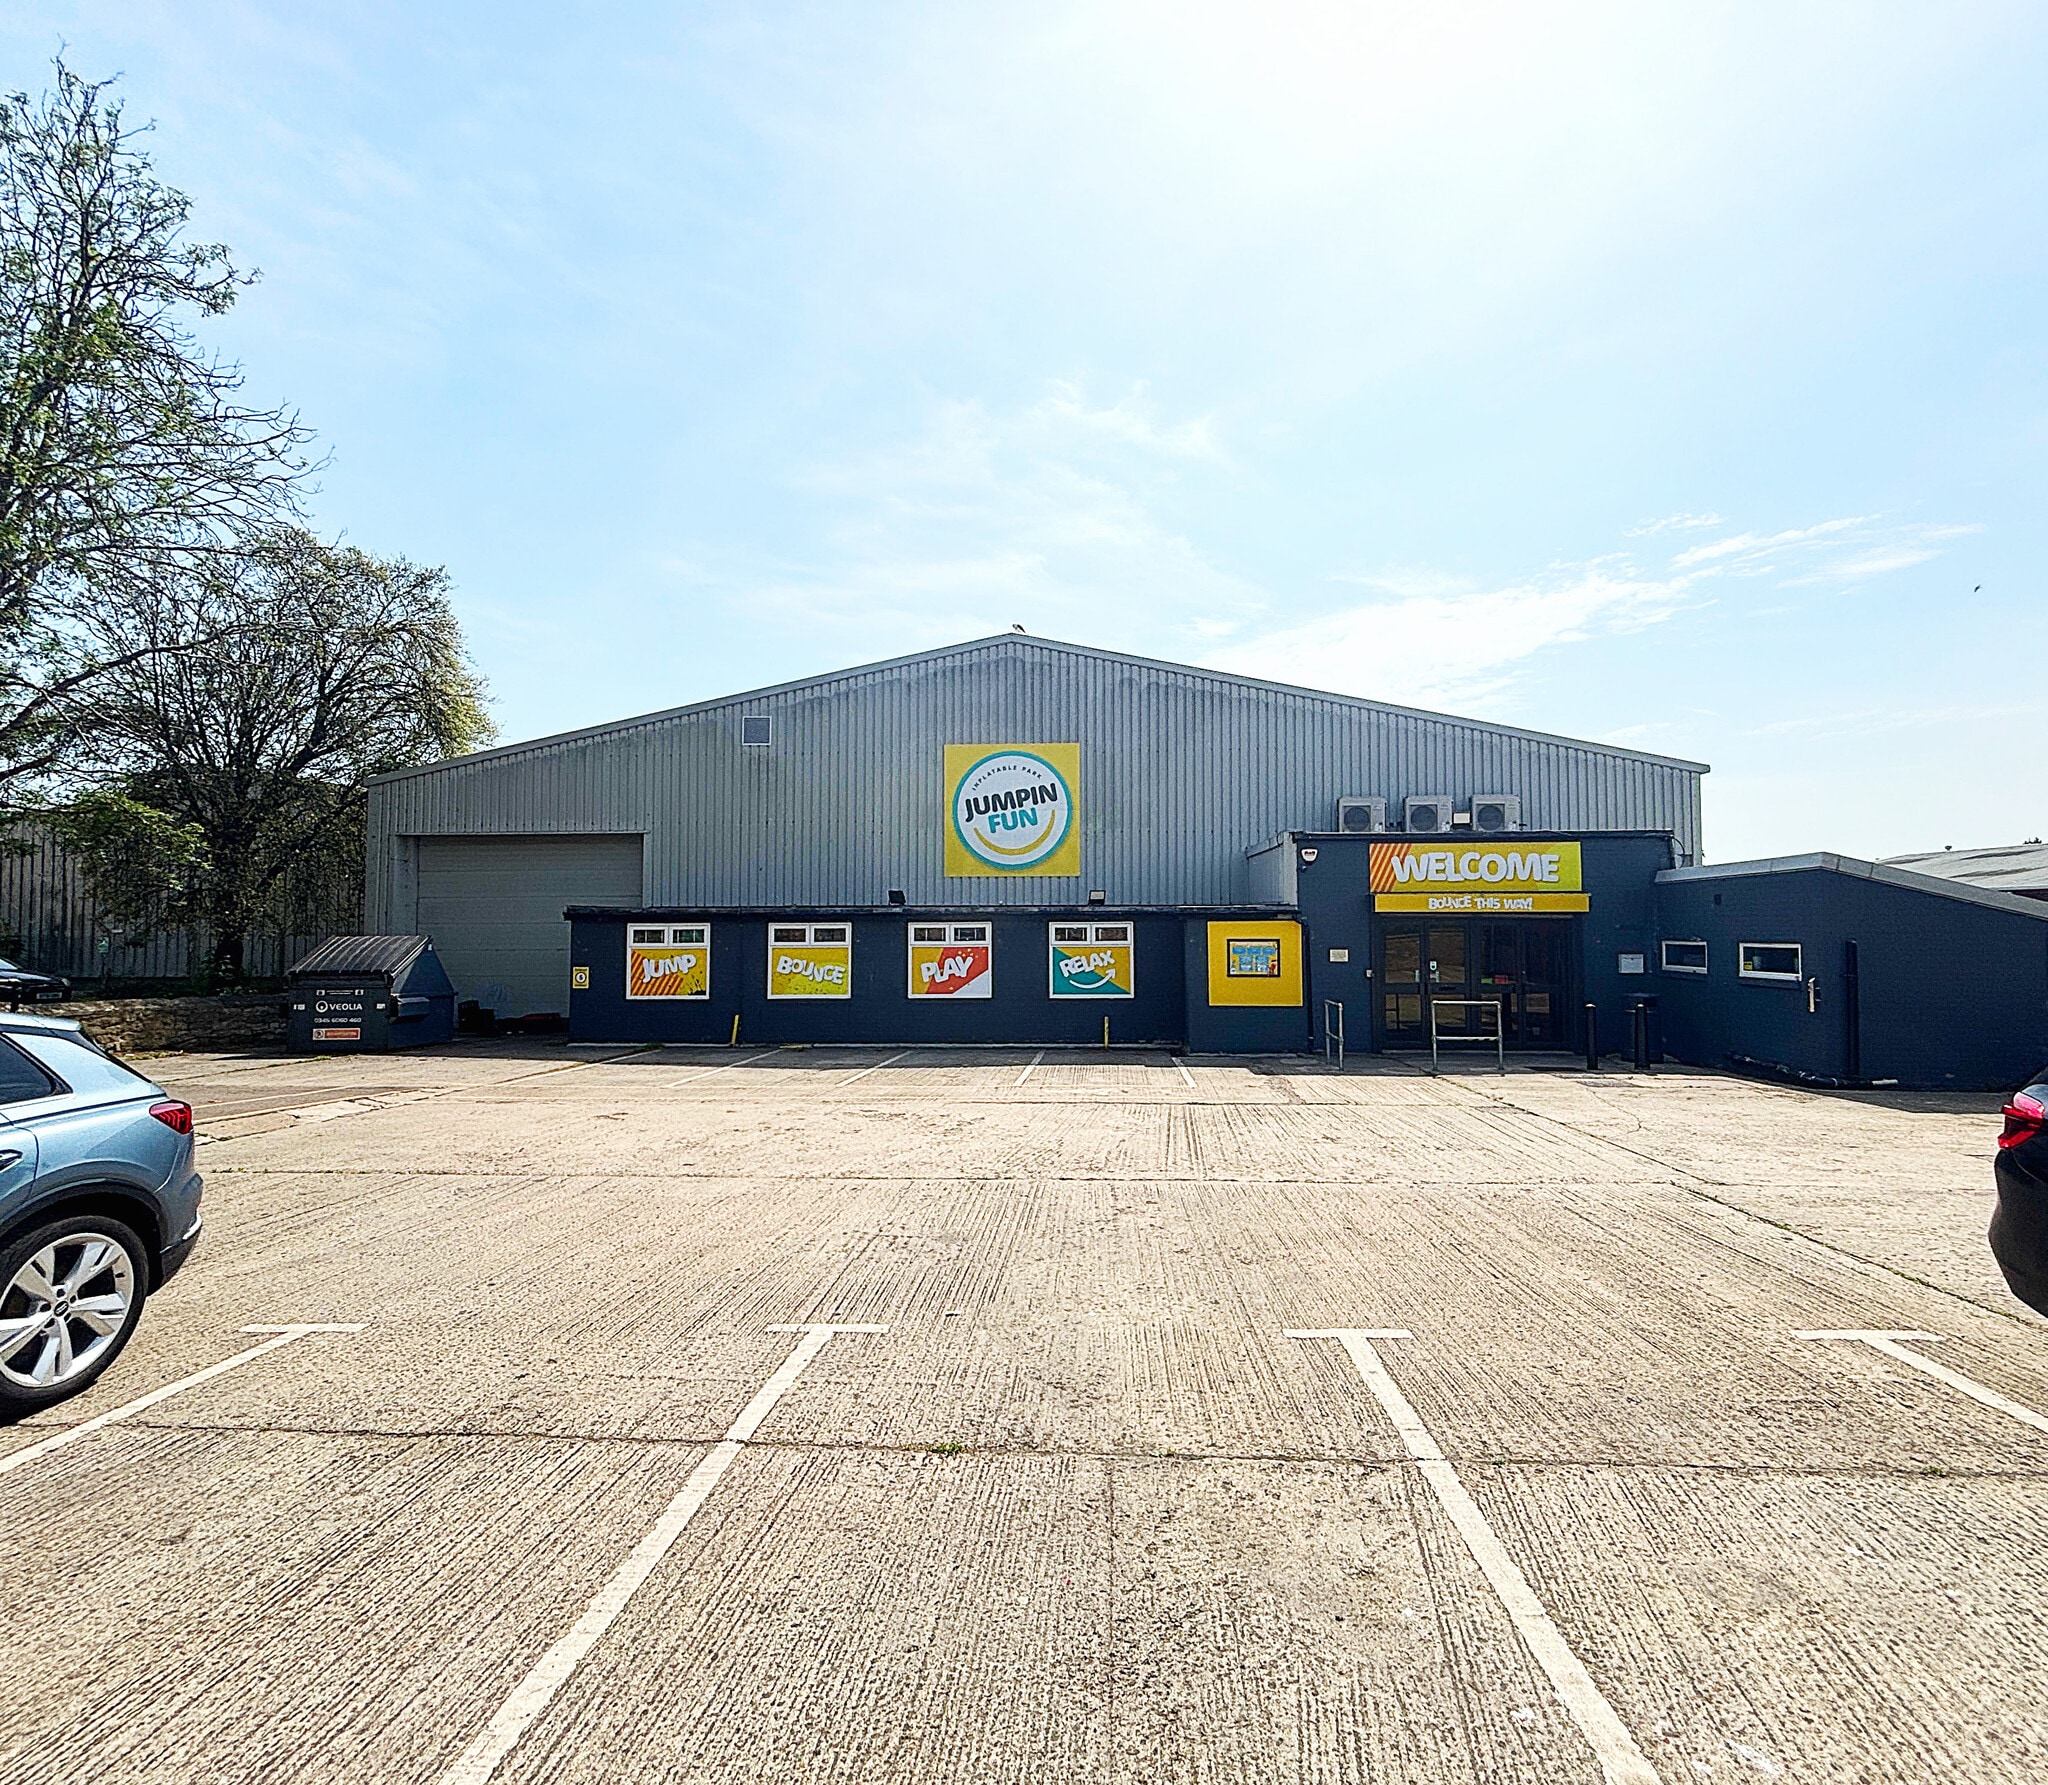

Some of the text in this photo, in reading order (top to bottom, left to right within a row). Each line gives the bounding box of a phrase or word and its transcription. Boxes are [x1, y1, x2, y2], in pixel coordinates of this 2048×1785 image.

[971, 765, 1043, 791] INFLATABLE PARK
[965, 782, 1058, 823] JUMPIN
[988, 807, 1039, 834] FUN
[1391, 851, 1560, 883] WELCOME
[1428, 895, 1533, 911] BOUNCE THIS WAY!
[641, 953, 697, 984] JUMP
[776, 954, 847, 985] BOUNCE
[920, 955, 974, 984] PLAY
[1059, 949, 1116, 978] RELAX
[329, 1003, 363, 1011] VEOLIA
